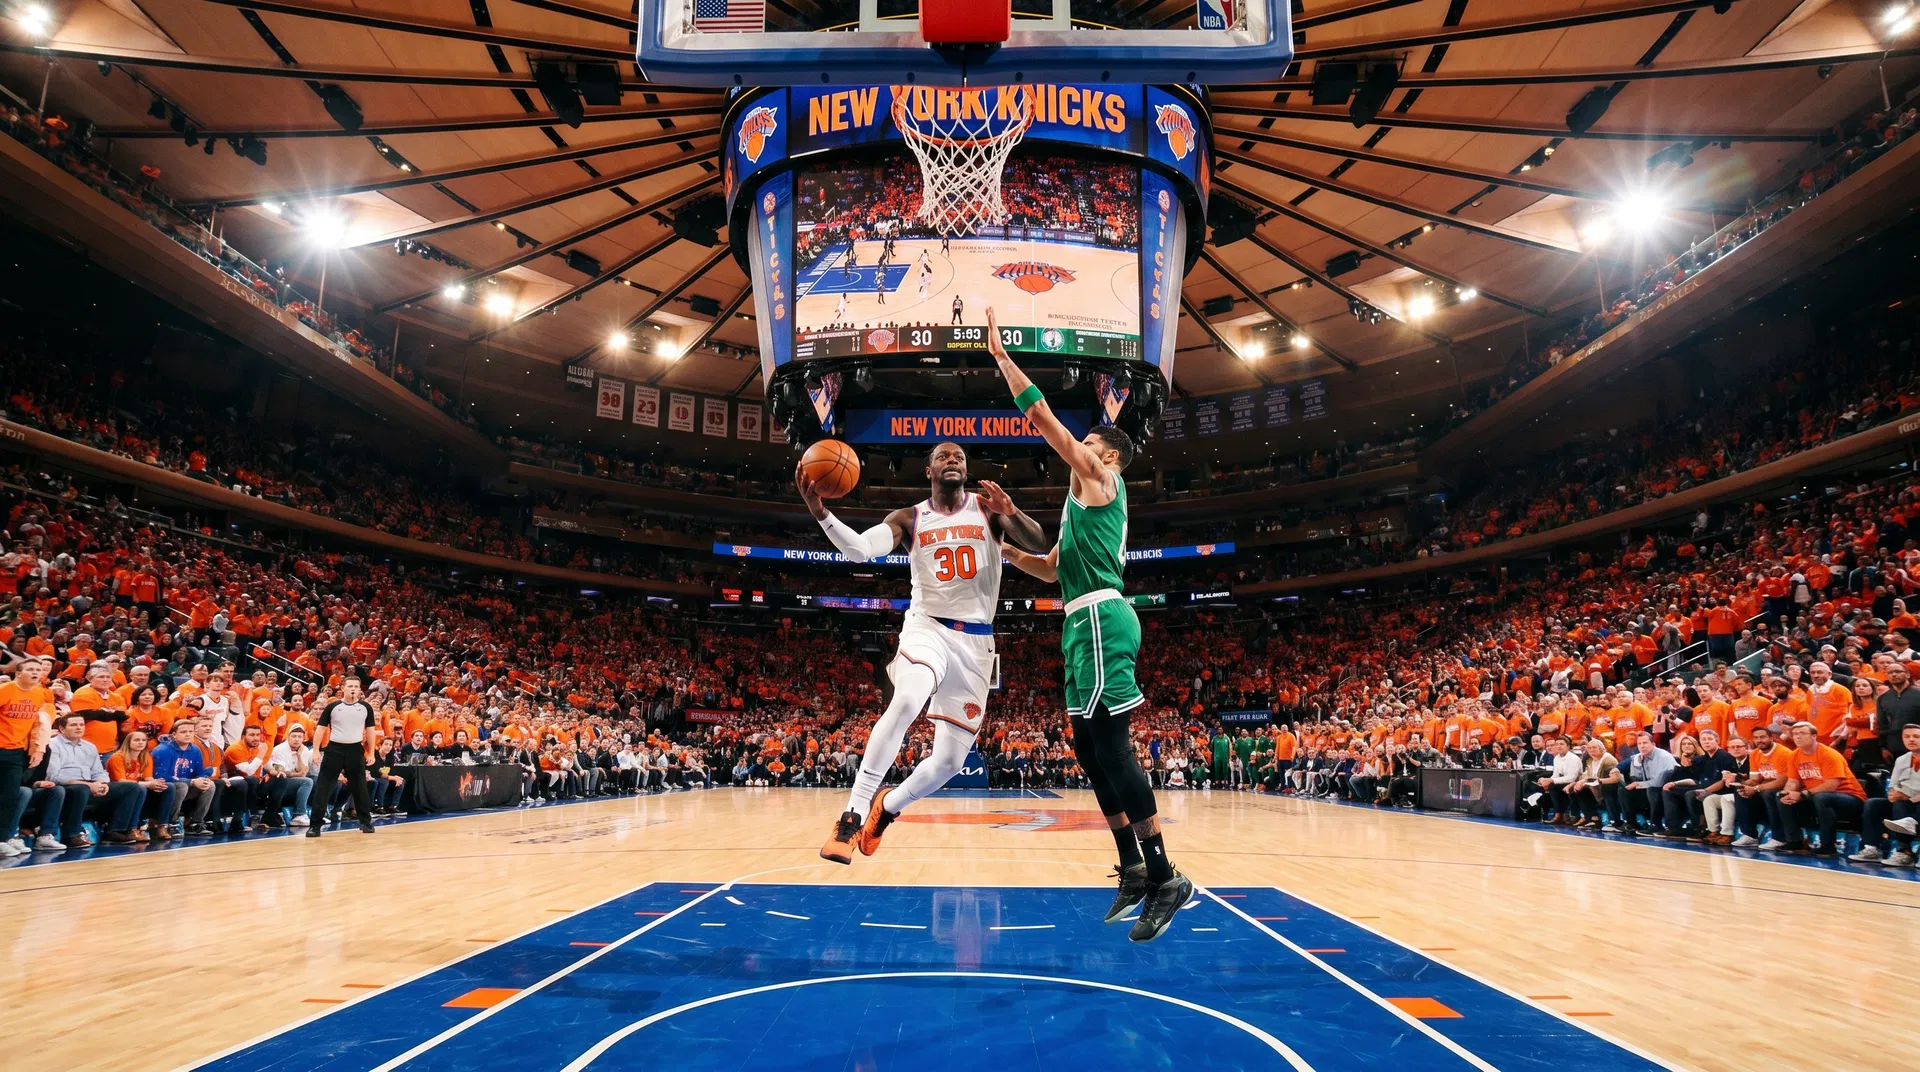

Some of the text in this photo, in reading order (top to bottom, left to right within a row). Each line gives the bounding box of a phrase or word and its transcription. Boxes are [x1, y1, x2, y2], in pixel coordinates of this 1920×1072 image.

[1203, 16, 1221, 28] NBA
[808, 84, 1125, 136] NEW YORK KNICKS
[911, 330, 932, 346] 30
[1002, 329, 1023, 346] 30
[891, 417, 927, 436] NEW
[933, 417, 977, 436] YORK
[918, 525, 985, 548] NEW YORK
[784, 549, 805, 559] NEW
[807, 551, 832, 561] YORK
[934, 545, 977, 581] 30
